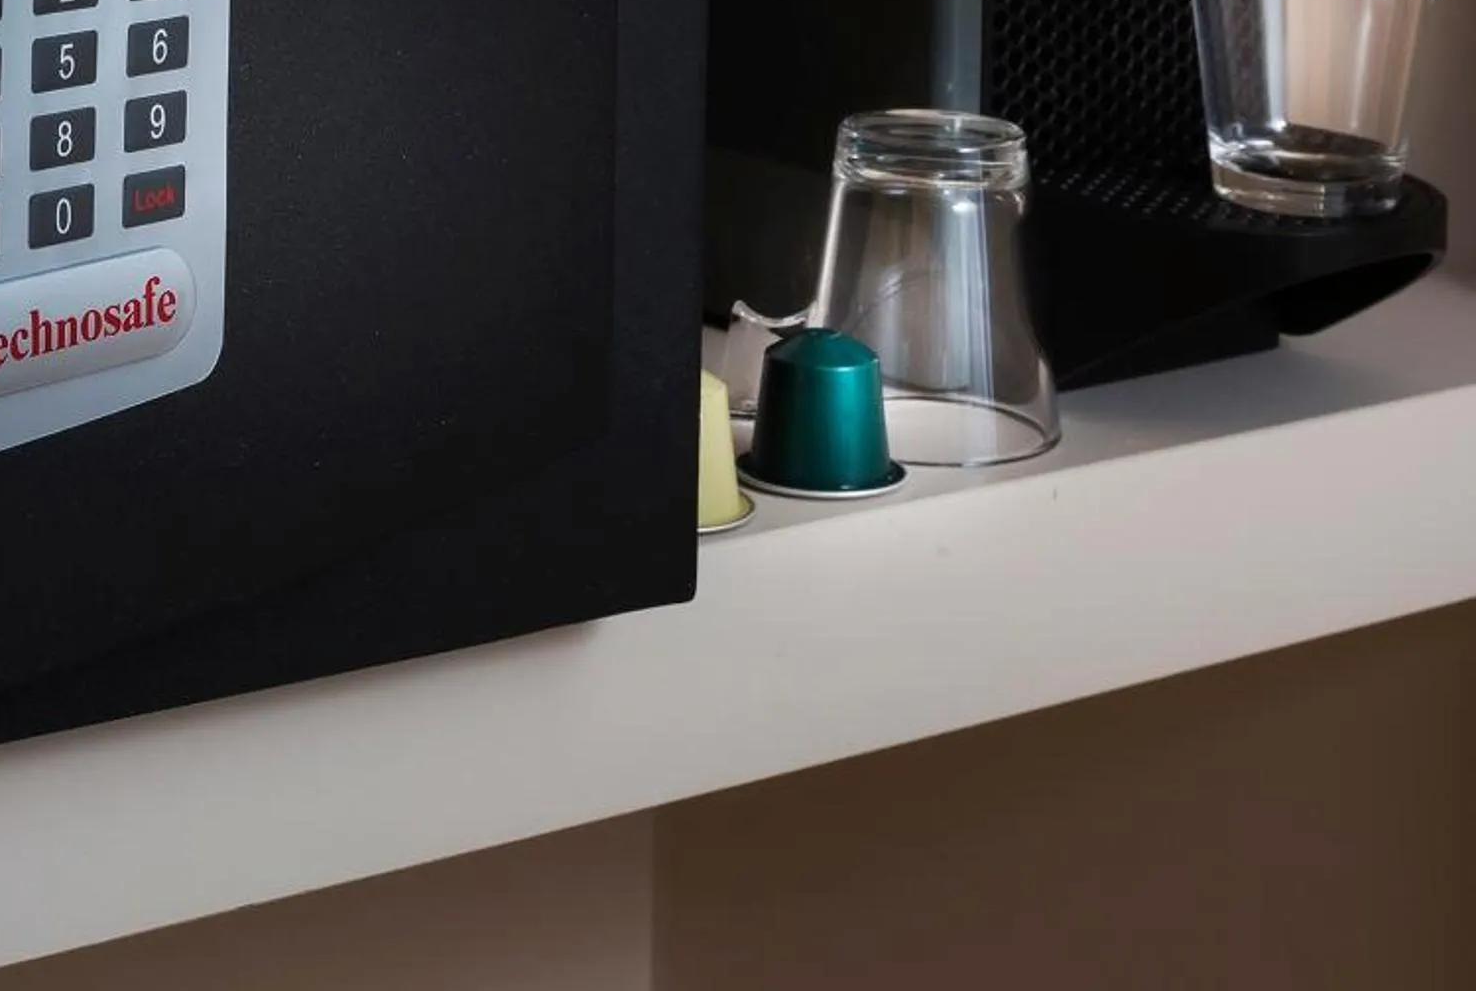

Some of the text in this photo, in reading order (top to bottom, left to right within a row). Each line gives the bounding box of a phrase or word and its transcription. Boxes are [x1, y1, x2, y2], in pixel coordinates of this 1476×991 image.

[58, 43, 75, 81] 5
[152, 29, 168, 64] 6
[56, 120, 73, 158] 8
[150, 104, 166, 139] 9
[134, 183, 175, 211] Lock
[56, 198, 72, 235] 0
